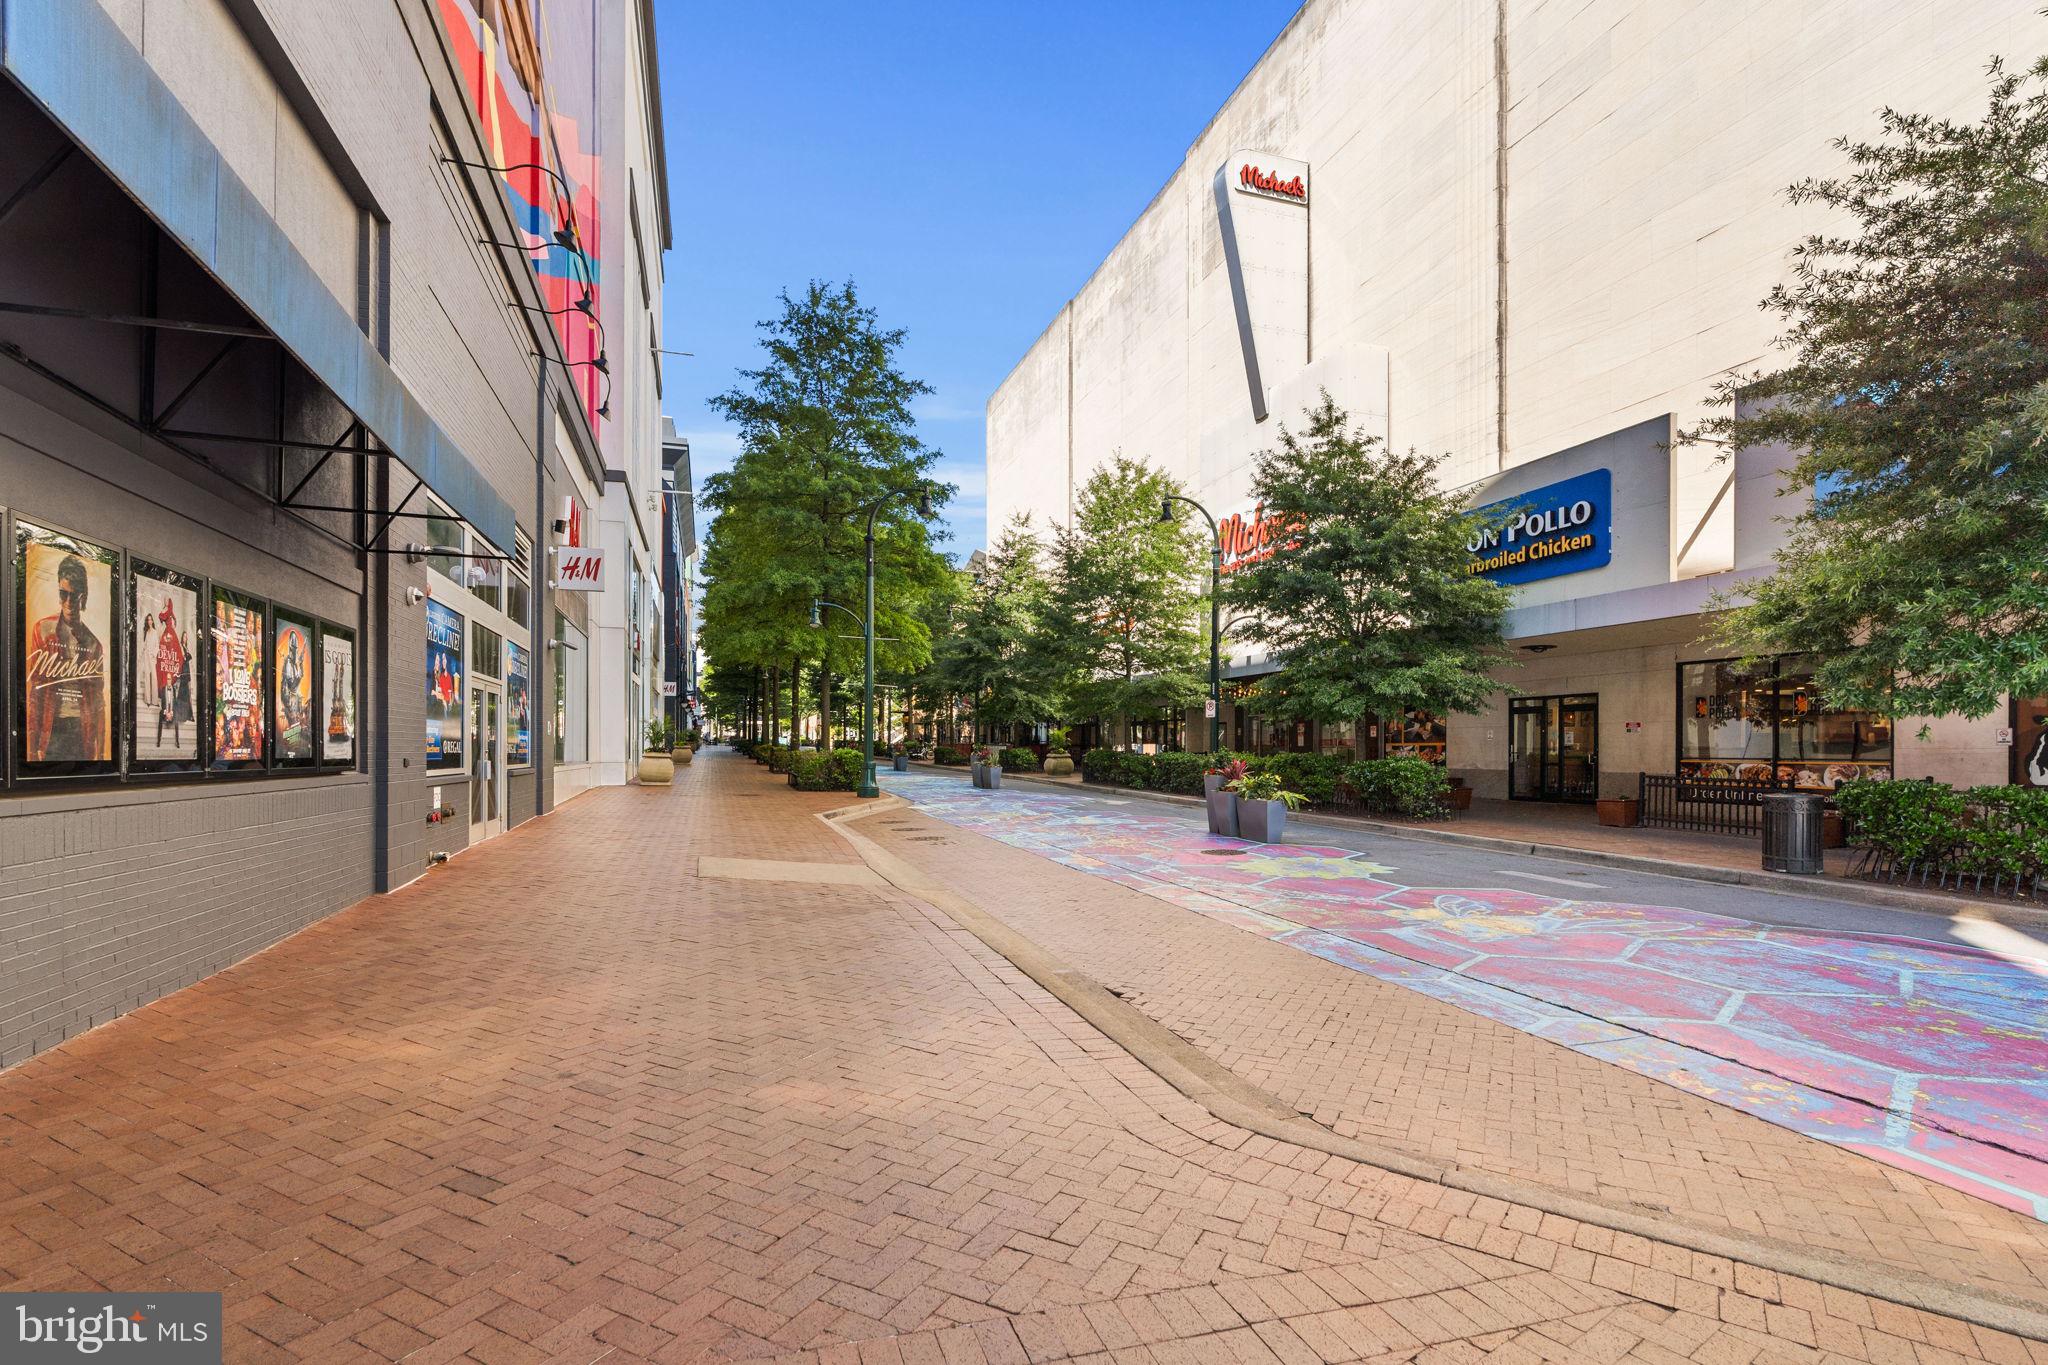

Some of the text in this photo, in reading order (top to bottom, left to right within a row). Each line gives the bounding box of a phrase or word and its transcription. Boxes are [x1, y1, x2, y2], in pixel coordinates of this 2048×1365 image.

[1240, 163, 1306, 197] Michaels
[1467, 500, 1592, 552] ON POLLO
[1465, 534, 1592, 574] arbroiled Chicken
[561, 556, 602, 582] H&M
[26, 649, 104, 678] Michael
[158, 648, 179, 662] DEVIL
[332, 650, 347, 666] GOD
[233, 668, 251, 685] LOVE
[222, 682, 257, 706] BOOSTERS
